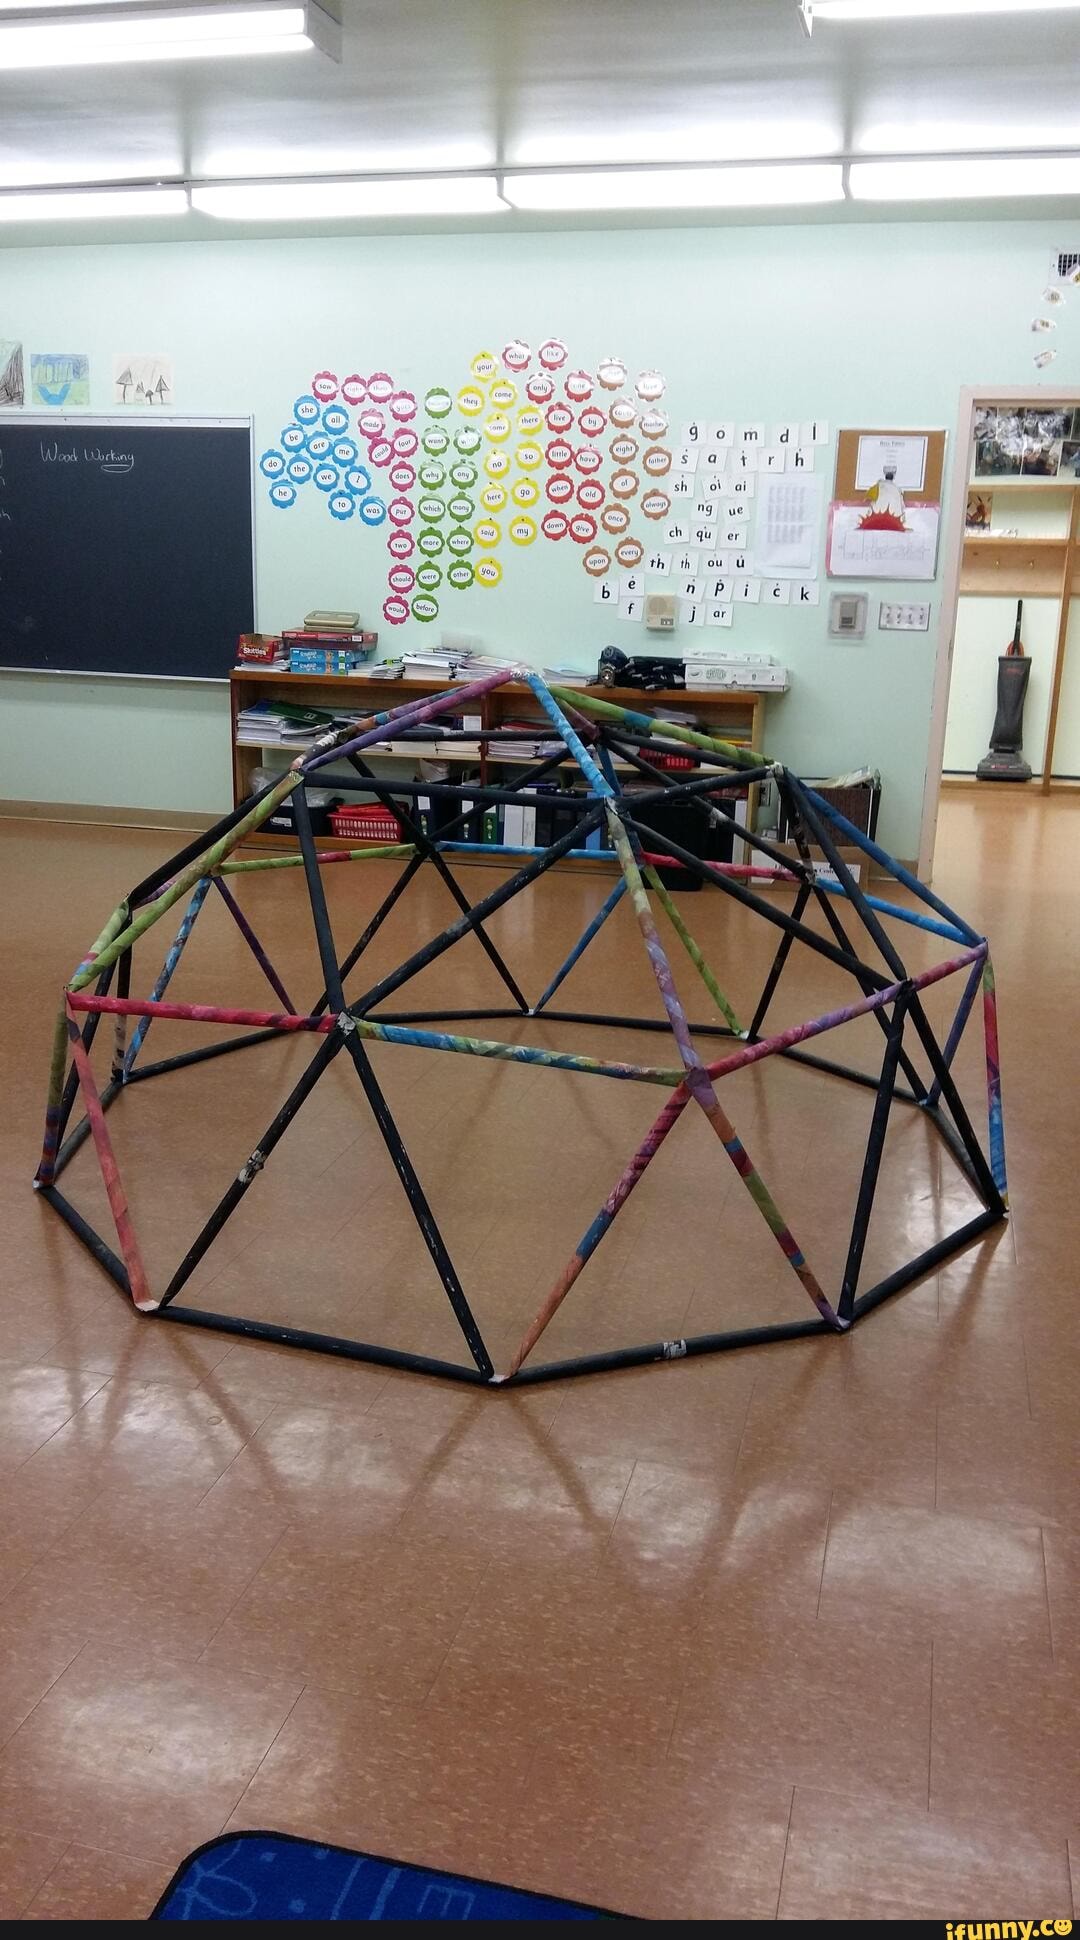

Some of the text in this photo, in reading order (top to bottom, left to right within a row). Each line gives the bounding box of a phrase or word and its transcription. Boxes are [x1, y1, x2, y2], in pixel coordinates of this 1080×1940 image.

[533, 384, 548, 394] only
[463, 397, 479, 407] they
[301, 406, 314, 414] she
[331, 416, 341, 424] all
[521, 416, 539, 424] there
[553, 414, 566, 422] live
[588, 417, 597, 426] by
[289, 434, 299, 442] be
[689, 425, 698, 441] g
[716, 429, 726, 439] o
[744, 429, 758, 441] m
[780, 428, 790, 443] d
[313, 441, 325, 450] are
[615, 445, 633, 454] eight
[40, 440, 134, 468] Wood Working
[551, 450, 568, 458] little
[708, 454, 717, 464] a
[268, 460, 278, 468] do
[492, 460, 502, 469] no
[680, 454, 688, 465] s
[740, 455, 748, 467] t
[768, 455, 775, 466] r
[795, 452, 805, 467] h
[294, 465, 306, 473] the
[425, 472, 439, 480] why
[457, 471, 470, 479] any
[551, 485, 568, 493] when
[674, 481, 688, 493] sh
[709, 479, 722, 492] oi
[734, 480, 747, 491] ai
[278, 489, 288, 497] he
[486, 493, 501, 501] here
[520, 489, 530, 497] go
[423, 505, 442, 513] which
[452, 504, 470, 512] many
[645, 501, 667, 509] always
[697, 503, 713, 517] ng
[395, 508, 407, 516] put
[728, 505, 744, 516] ue
[607, 514, 624, 523] once
[480, 529, 495, 537] said
[516, 527, 529, 536] my
[575, 524, 590, 534] give
[668, 526, 683, 538] ch
[696, 527, 712, 542] qu
[727, 531, 740, 541] er
[620, 548, 639, 557] every
[588, 557, 606, 567] upon
[650, 557, 665, 569] th
[680, 557, 690, 569] th
[707, 557, 723, 567] ou
[736, 558, 745, 568] u
[481, 567, 496, 577] you
[628, 578, 636, 590] e
[686, 582, 695, 594] n
[601, 585, 611, 599] b
[714, 582, 725, 597] p
[773, 586, 781, 597] c
[801, 587, 810, 600] k
[388, 605, 405, 614] would
[415, 604, 435, 613] before
[627, 602, 634, 615] f
[713, 608, 727, 618] ar
[689, 606, 696, 622] j
